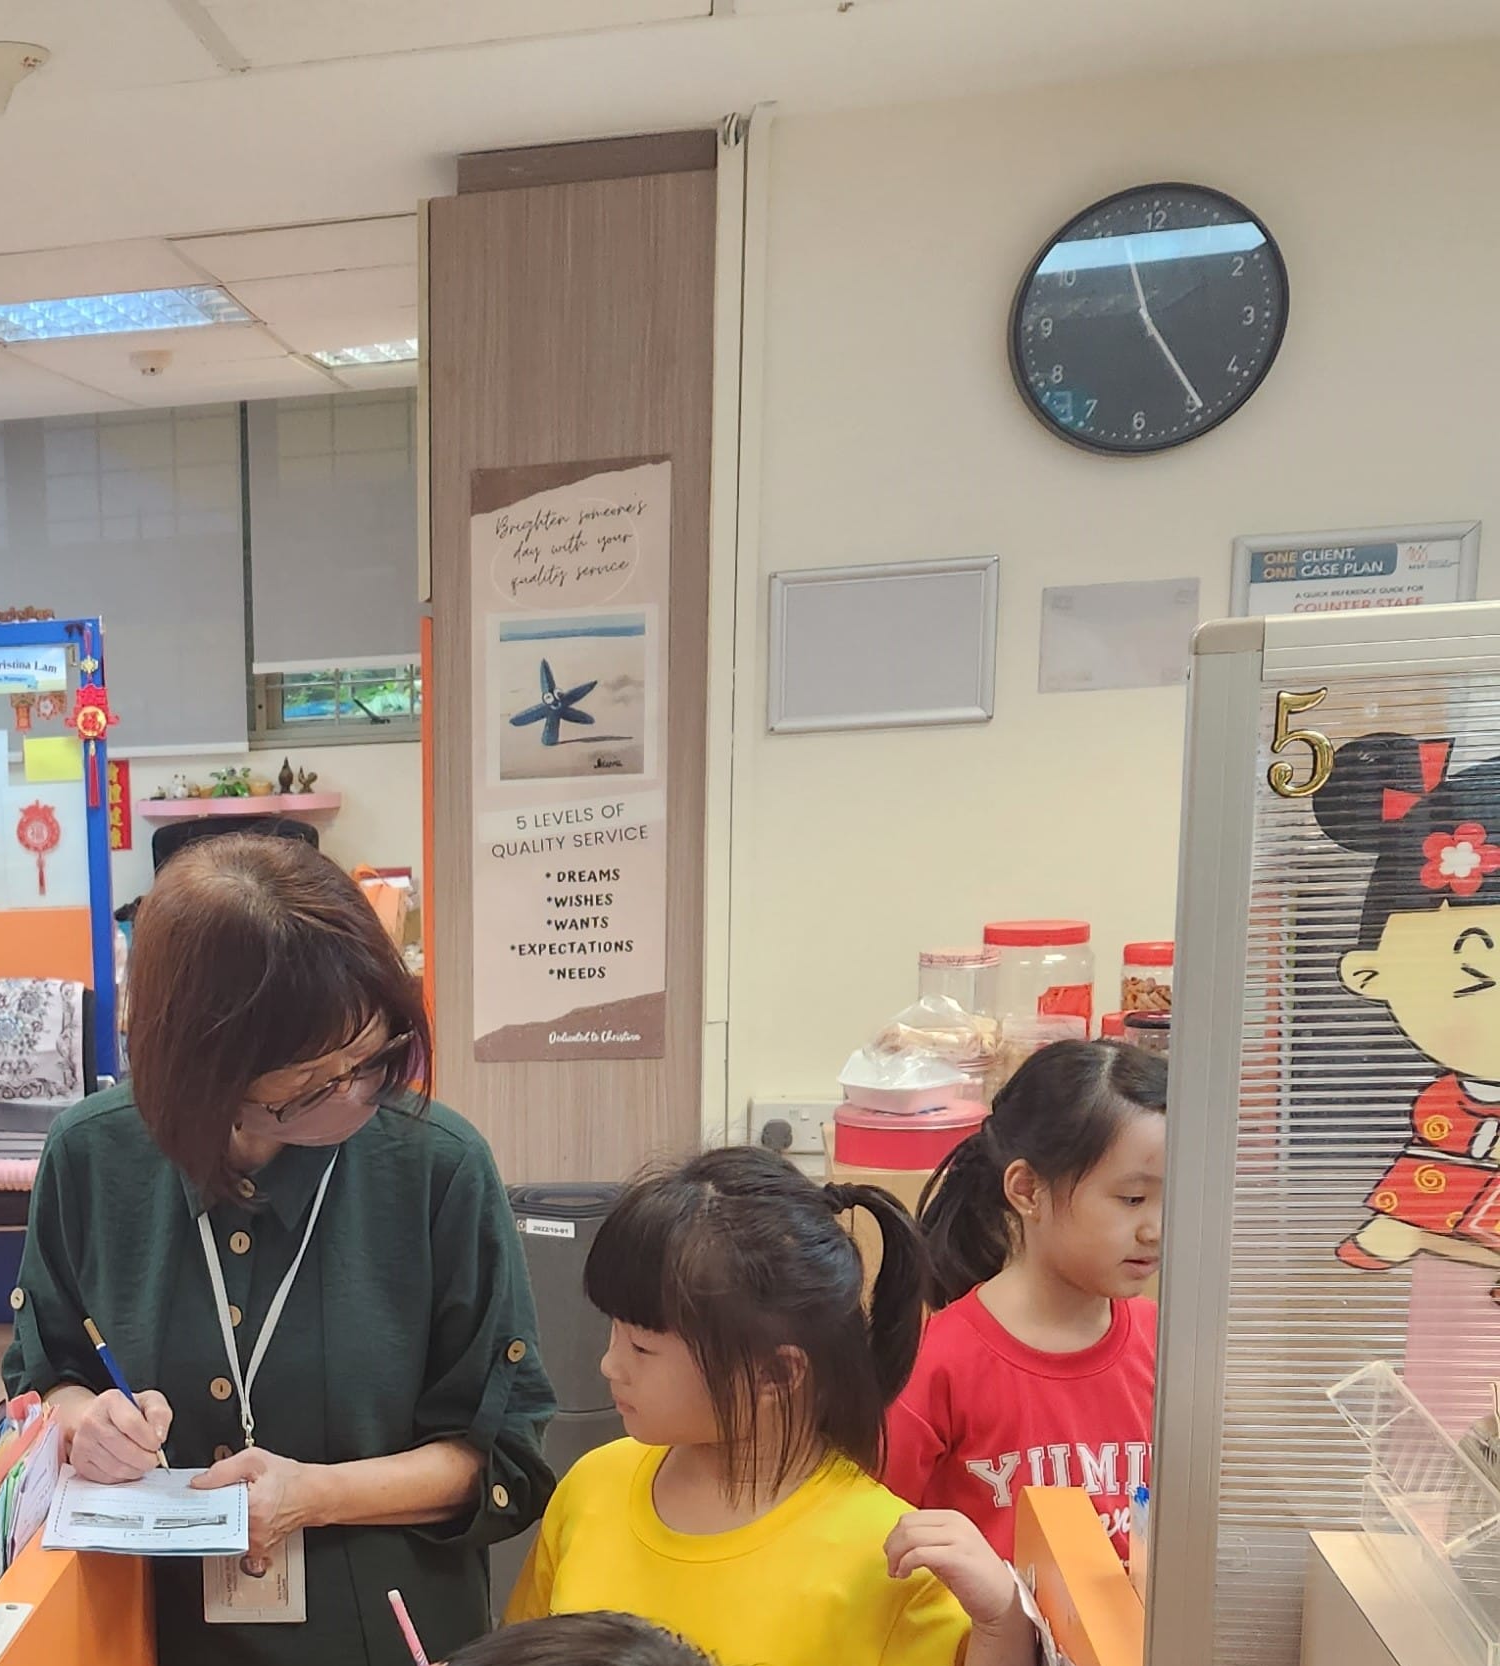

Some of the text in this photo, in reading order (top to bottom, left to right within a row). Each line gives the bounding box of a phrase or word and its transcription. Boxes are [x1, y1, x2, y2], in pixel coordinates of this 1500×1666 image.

[1145, 212, 1167, 230] 12
[1232, 257, 1244, 277] 2
[1242, 306, 1254, 325] 3
[1041, 319, 1052, 337] 9
[1052, 365, 1063, 382] 8
[1227, 356, 1238, 374] 4
[1085, 399, 1097, 418] 7
[1133, 412, 1145, 430] 6
[496, 510, 569, 543] Brighten
[514, 530, 633, 563] day with your
[1264, 548, 1356, 564] ONE CLIENT,
[511, 560, 629, 595] quality service
[1263, 561, 1383, 579] ONE CASE PLAN
[34, 661, 57, 673] Lam
[1266, 685, 1336, 799] 5
[517, 803, 625, 830] 5 LEVELS OF
[491, 825, 648, 859] QUALITY SERVICE
[965, 1442, 1153, 1508] YUMI
